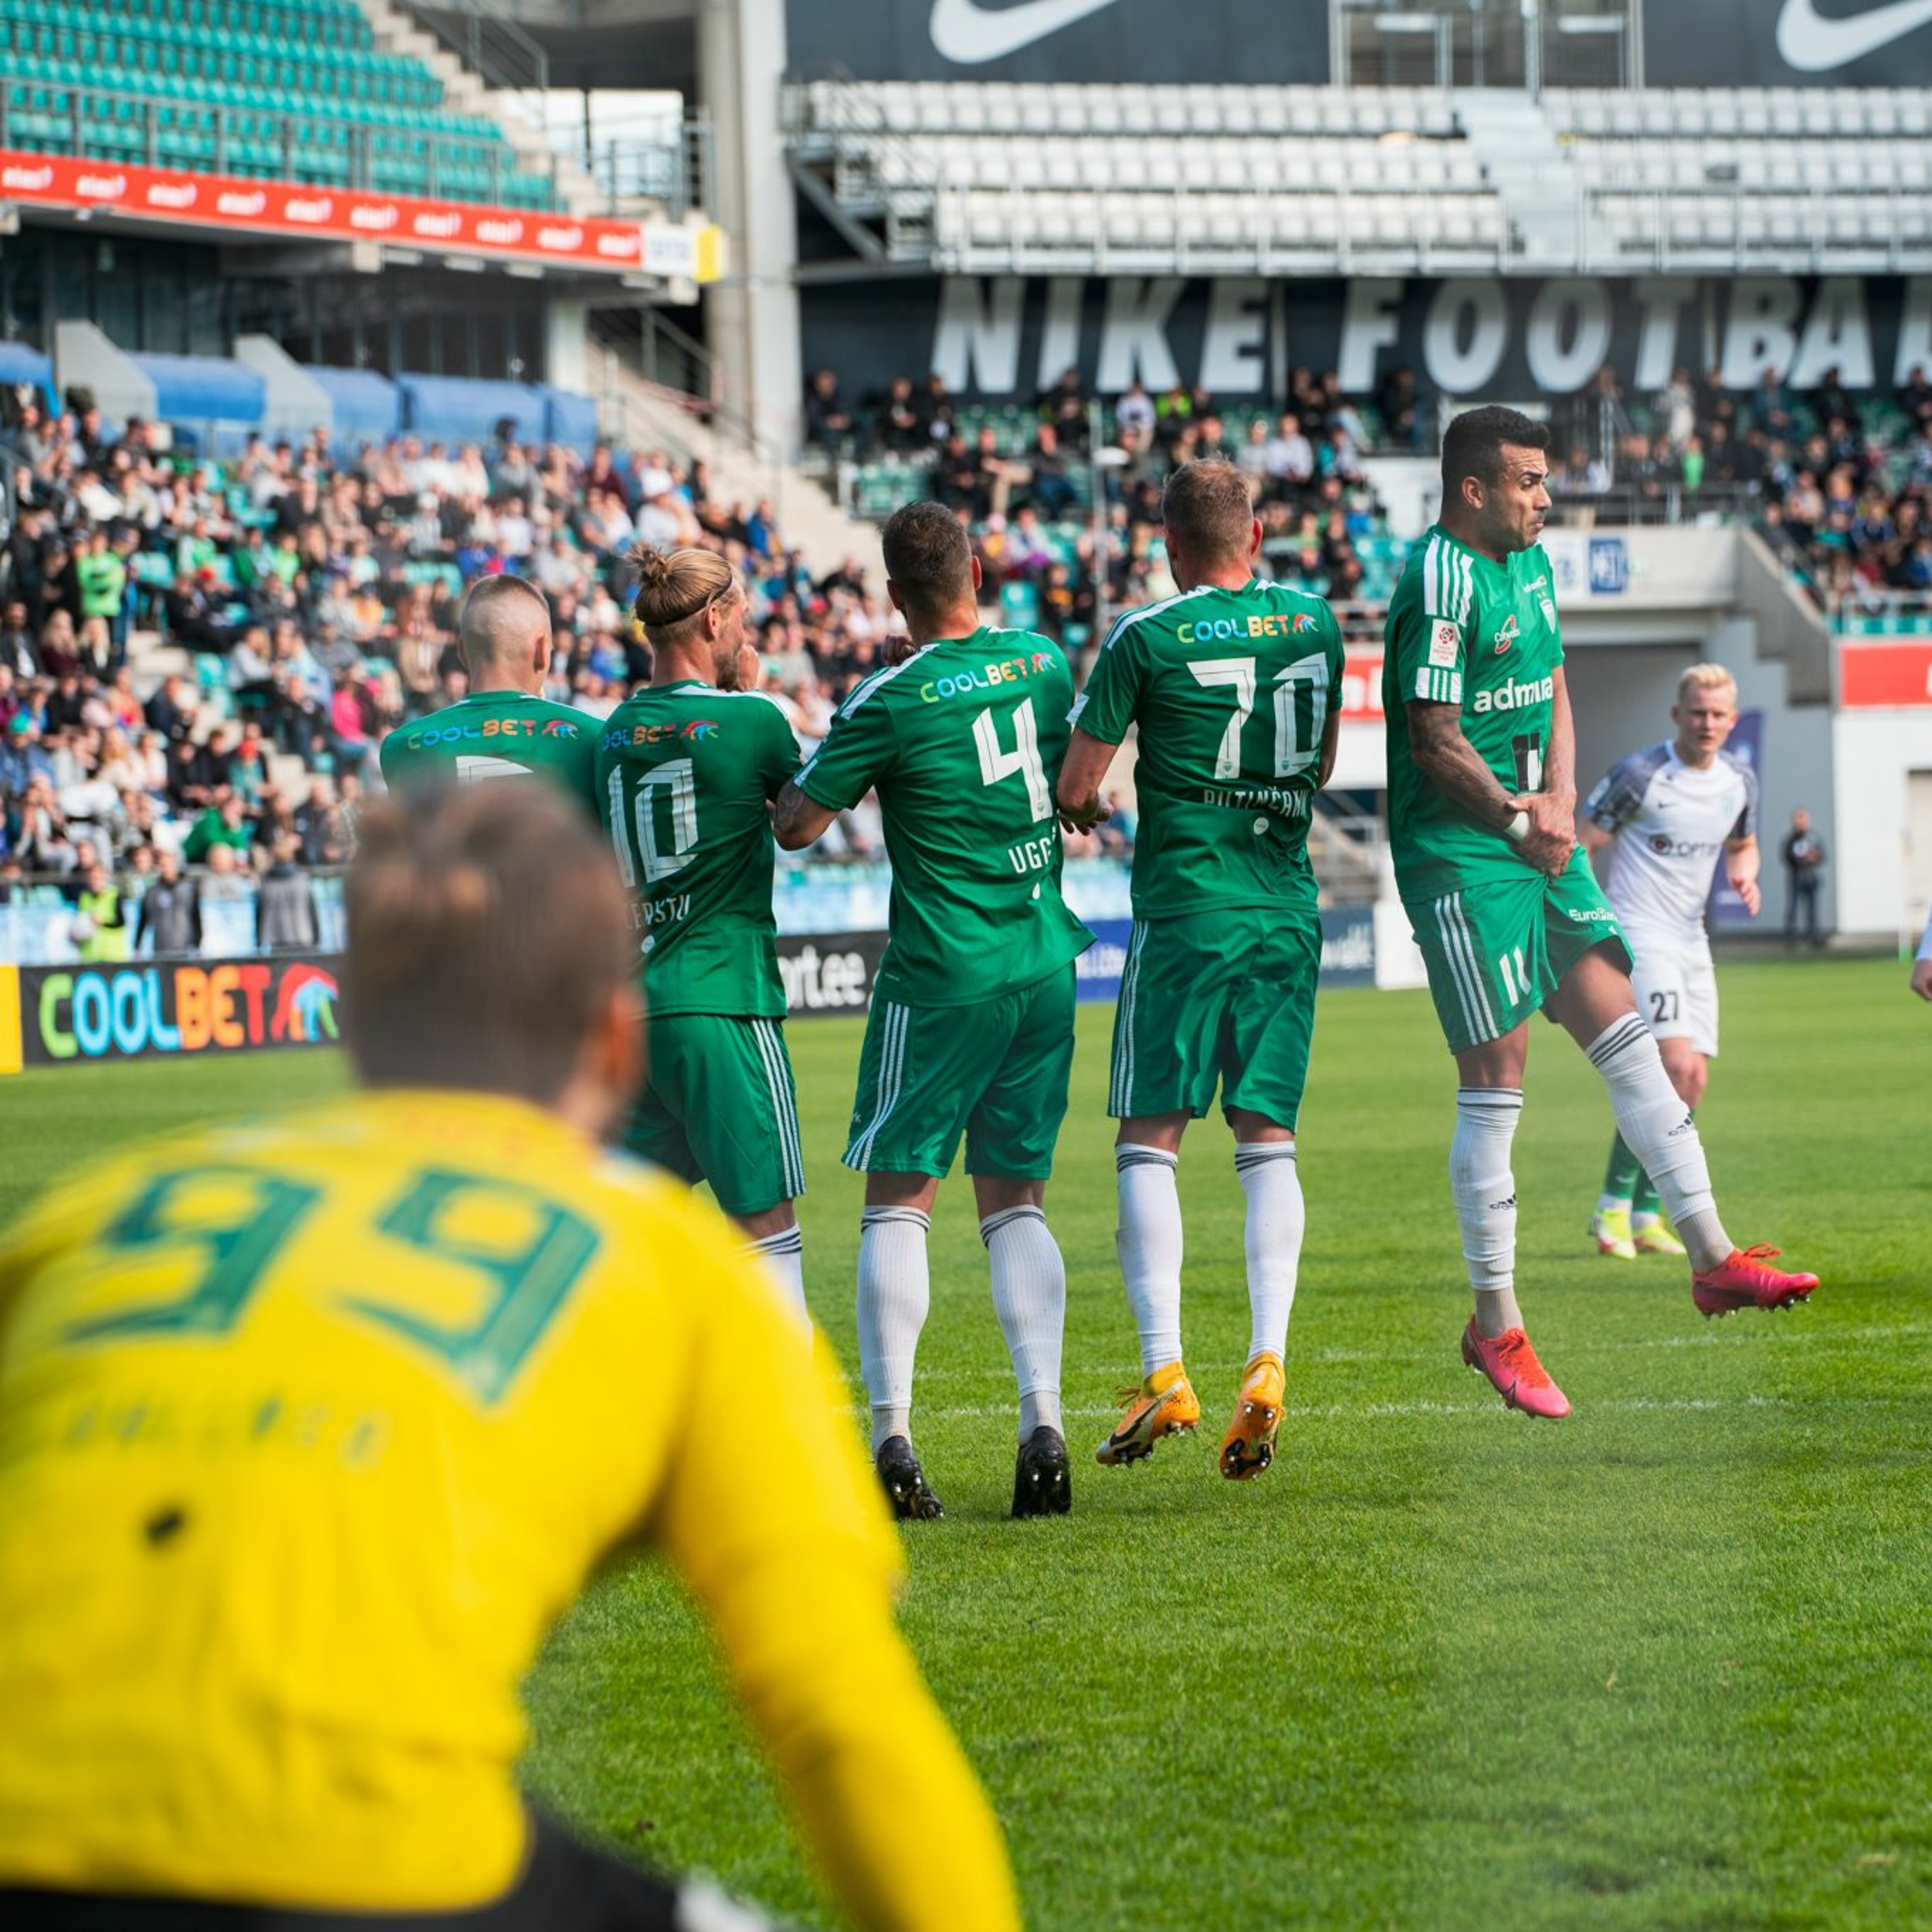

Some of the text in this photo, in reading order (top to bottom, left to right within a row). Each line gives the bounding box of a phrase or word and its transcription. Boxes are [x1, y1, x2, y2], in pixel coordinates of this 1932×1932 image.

[931, 275, 1267, 393] NIKE
[1177, 614, 1289, 643] COOLBET
[920, 658, 1028, 703] COOLBET
[1186, 652, 1329, 779] 70
[408, 719, 536, 750] COOLBET
[972, 697, 1053, 823] 4
[607, 757, 699, 888] 10
[39, 964, 270, 1058] COOLBET
[1650, 990, 1678, 1023] 27
